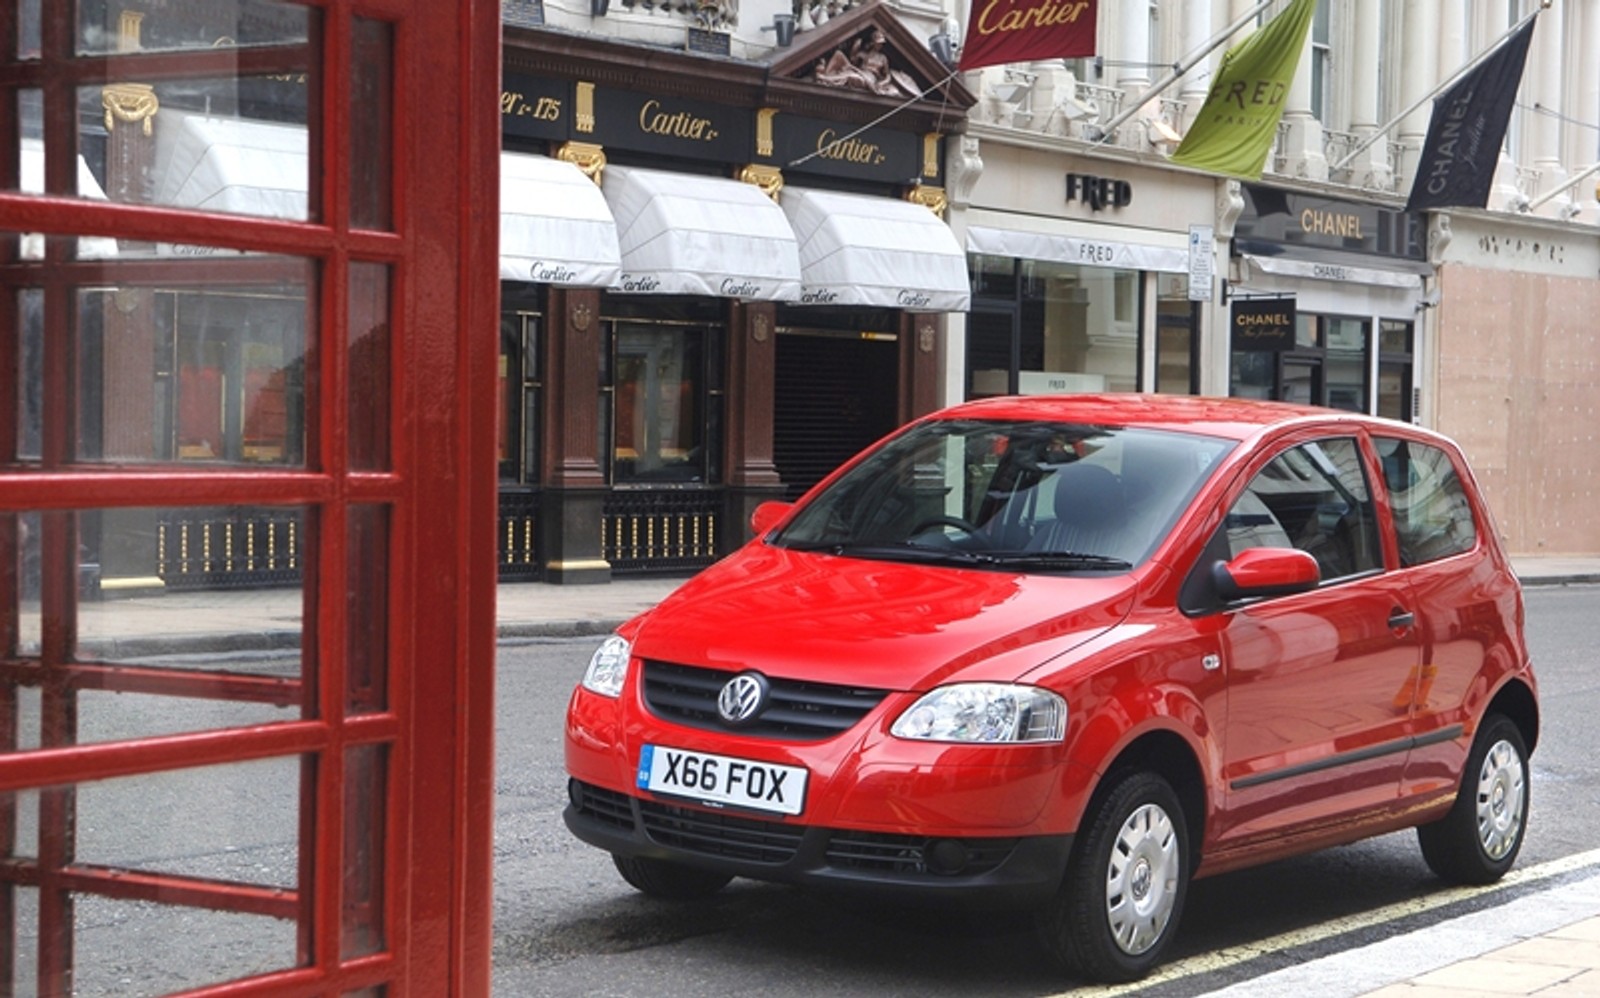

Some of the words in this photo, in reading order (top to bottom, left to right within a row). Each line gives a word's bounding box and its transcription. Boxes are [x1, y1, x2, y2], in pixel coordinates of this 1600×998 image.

[978, 0, 1089, 35] Cartier
[1206, 80, 1285, 110] FRED
[533, 98, 561, 121] 175
[639, 100, 711, 140] Cartier
[817, 127, 879, 164] Cartier
[1427, 91, 1473, 194] CHANEL
[1065, 173, 1132, 212] FRED
[1302, 208, 1363, 239] CHANEL
[1080, 244, 1113, 263] FRED
[530, 261, 577, 282] Cartier
[1313, 265, 1346, 279] CHANEL
[720, 278, 761, 296] Cartier
[801, 286, 838, 303] artier
[898, 289, 931, 306] Cartier
[1236, 313, 1290, 326] CHANEL
[663, 752, 719, 791] X66
[726, 762, 788, 803] FOX
